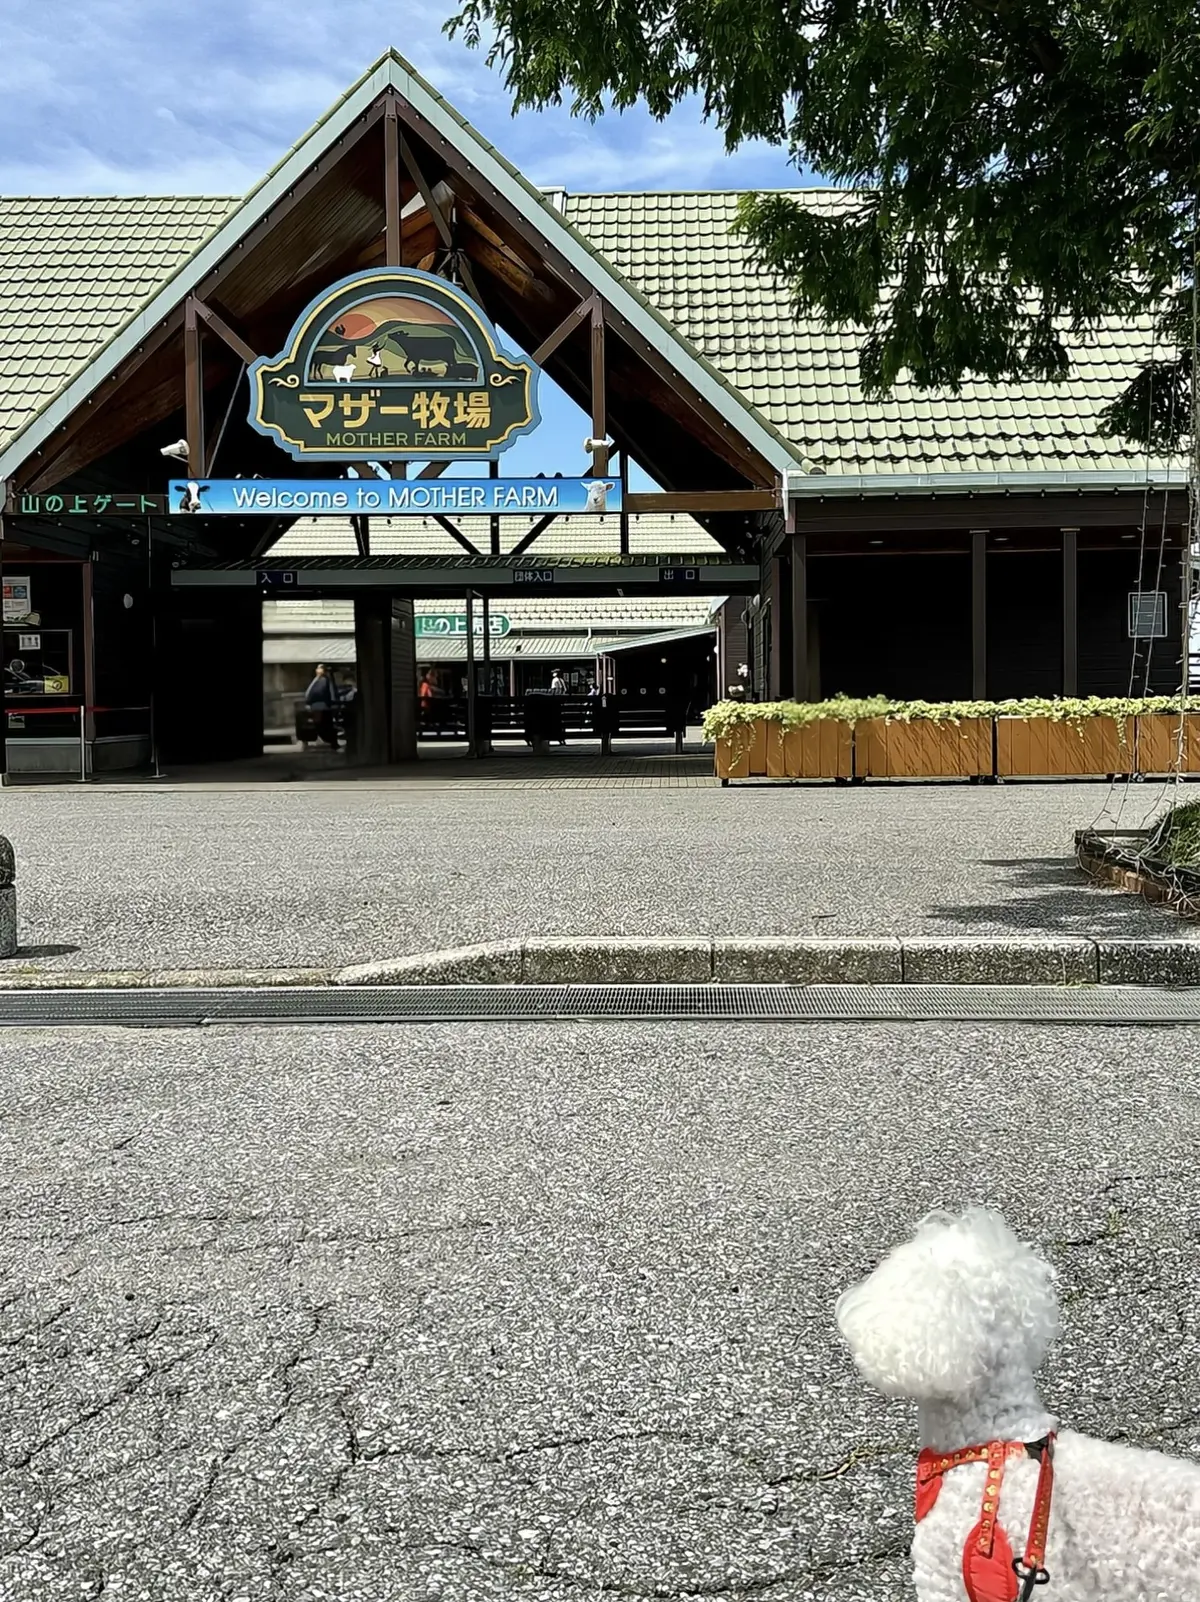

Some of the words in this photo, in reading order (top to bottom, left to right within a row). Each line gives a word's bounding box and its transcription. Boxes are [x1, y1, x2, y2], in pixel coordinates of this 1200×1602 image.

[299, 389, 492, 429] マザー牧場
[326, 432, 408, 446] MOTHER
[414, 432, 467, 446] FARM
[22, 494, 157, 514] 山の上ゲート
[232, 486, 348, 508] Welcome
[356, 487, 380, 508] to
[388, 486, 486, 507] MOTHER
[494, 486, 559, 507] FARM
[261, 573, 293, 584] 入口
[514, 570, 552, 582] 団体入口
[663, 569, 695, 580] 出口
